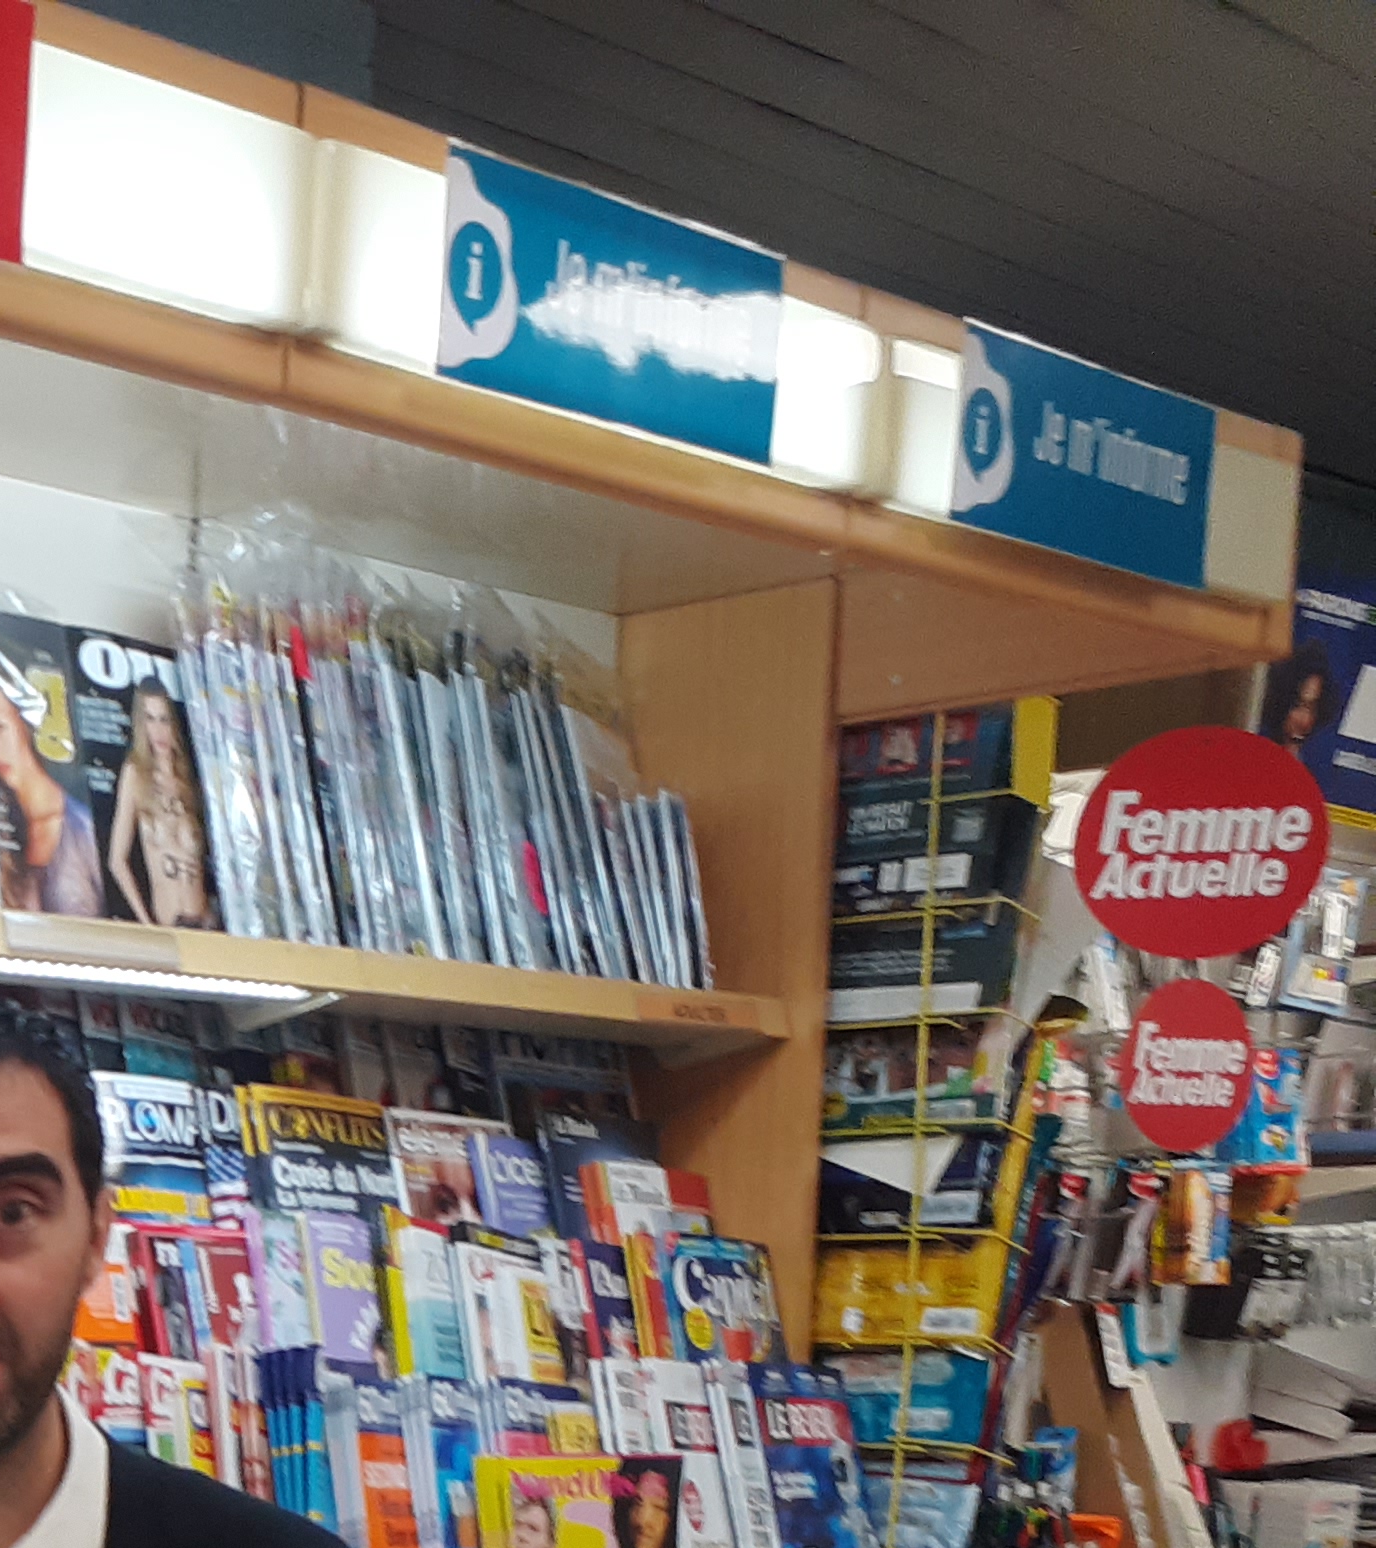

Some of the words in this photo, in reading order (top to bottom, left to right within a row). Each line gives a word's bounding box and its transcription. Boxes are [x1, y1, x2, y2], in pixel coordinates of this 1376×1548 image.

[1034, 400, 1068, 468] Je
[1099, 789, 1314, 856] Femme
[1090, 852, 1289, 901] Actuelle
[1134, 1020, 1247, 1074] Femme
[1128, 1069, 1235, 1109] Actuelle
